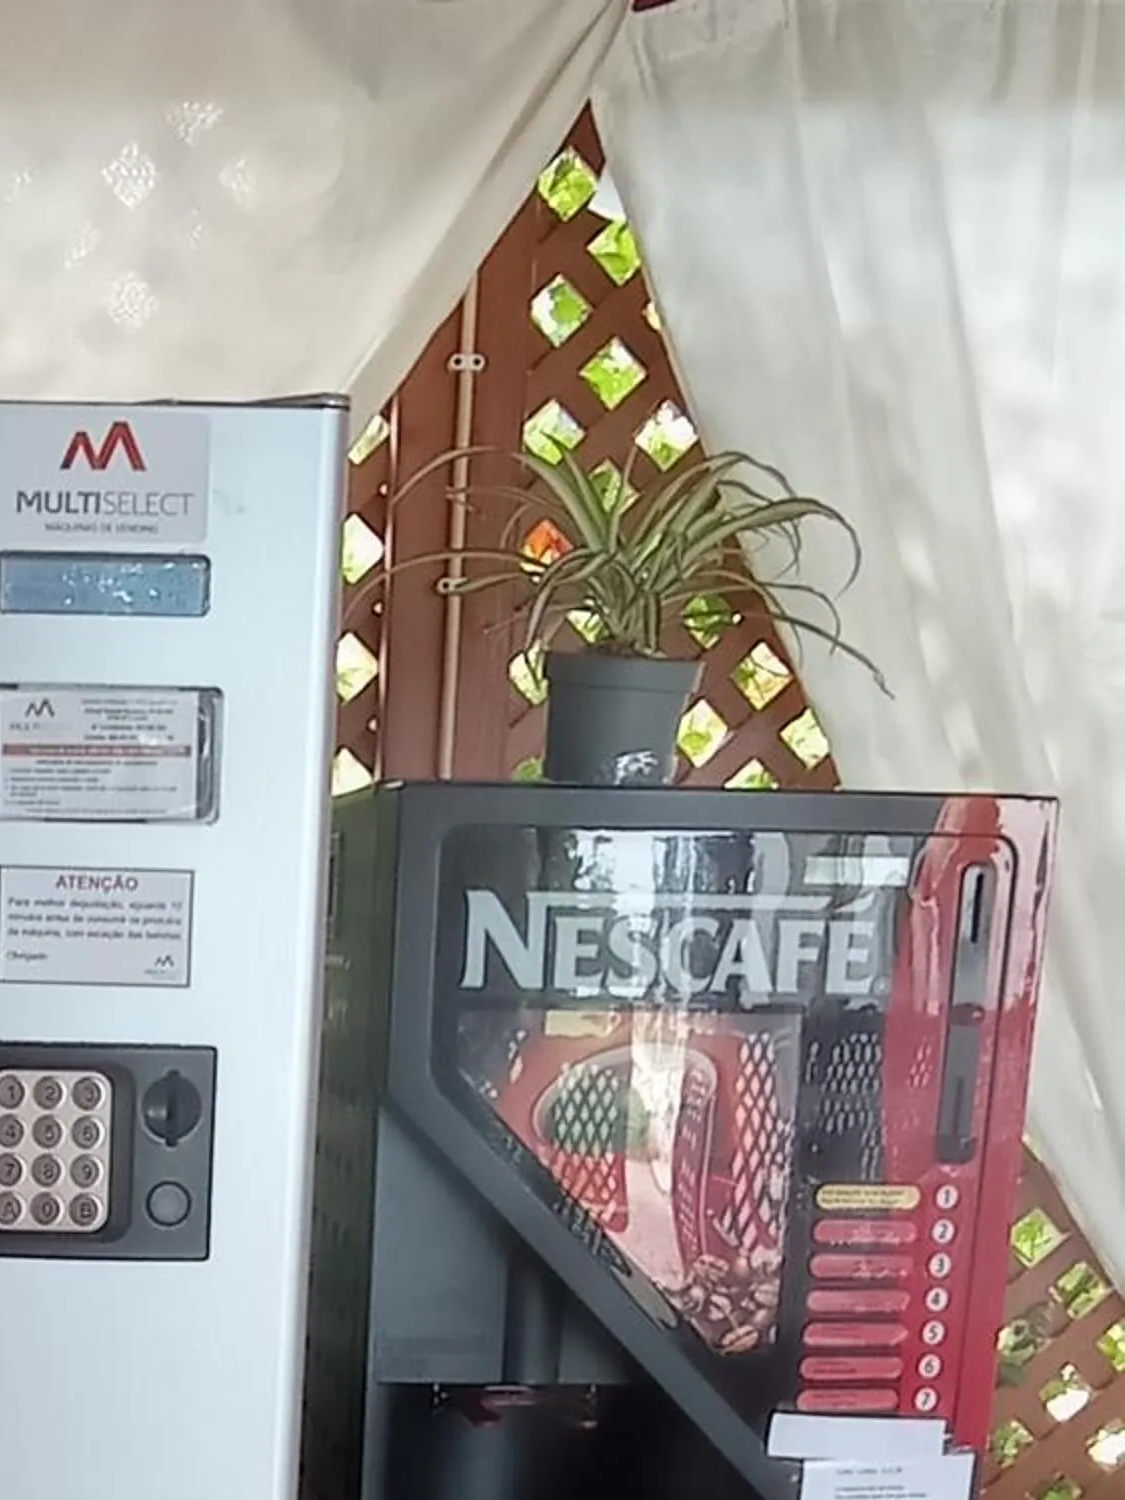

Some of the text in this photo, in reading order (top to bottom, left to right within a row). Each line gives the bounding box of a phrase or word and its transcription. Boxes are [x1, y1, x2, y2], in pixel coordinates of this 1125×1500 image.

[16, 490, 196, 516] MULTISELECT
[55, 874, 139, 894] ATENÇÃO
[459, 889, 875, 997] NESCAFÉ
[938, 1224, 948, 1239] 2
[936, 1257, 945, 1273] 3
[931, 1292, 941, 1307] 4
[928, 1324, 939, 1339] 5
[924, 1358, 934, 1374] 6
